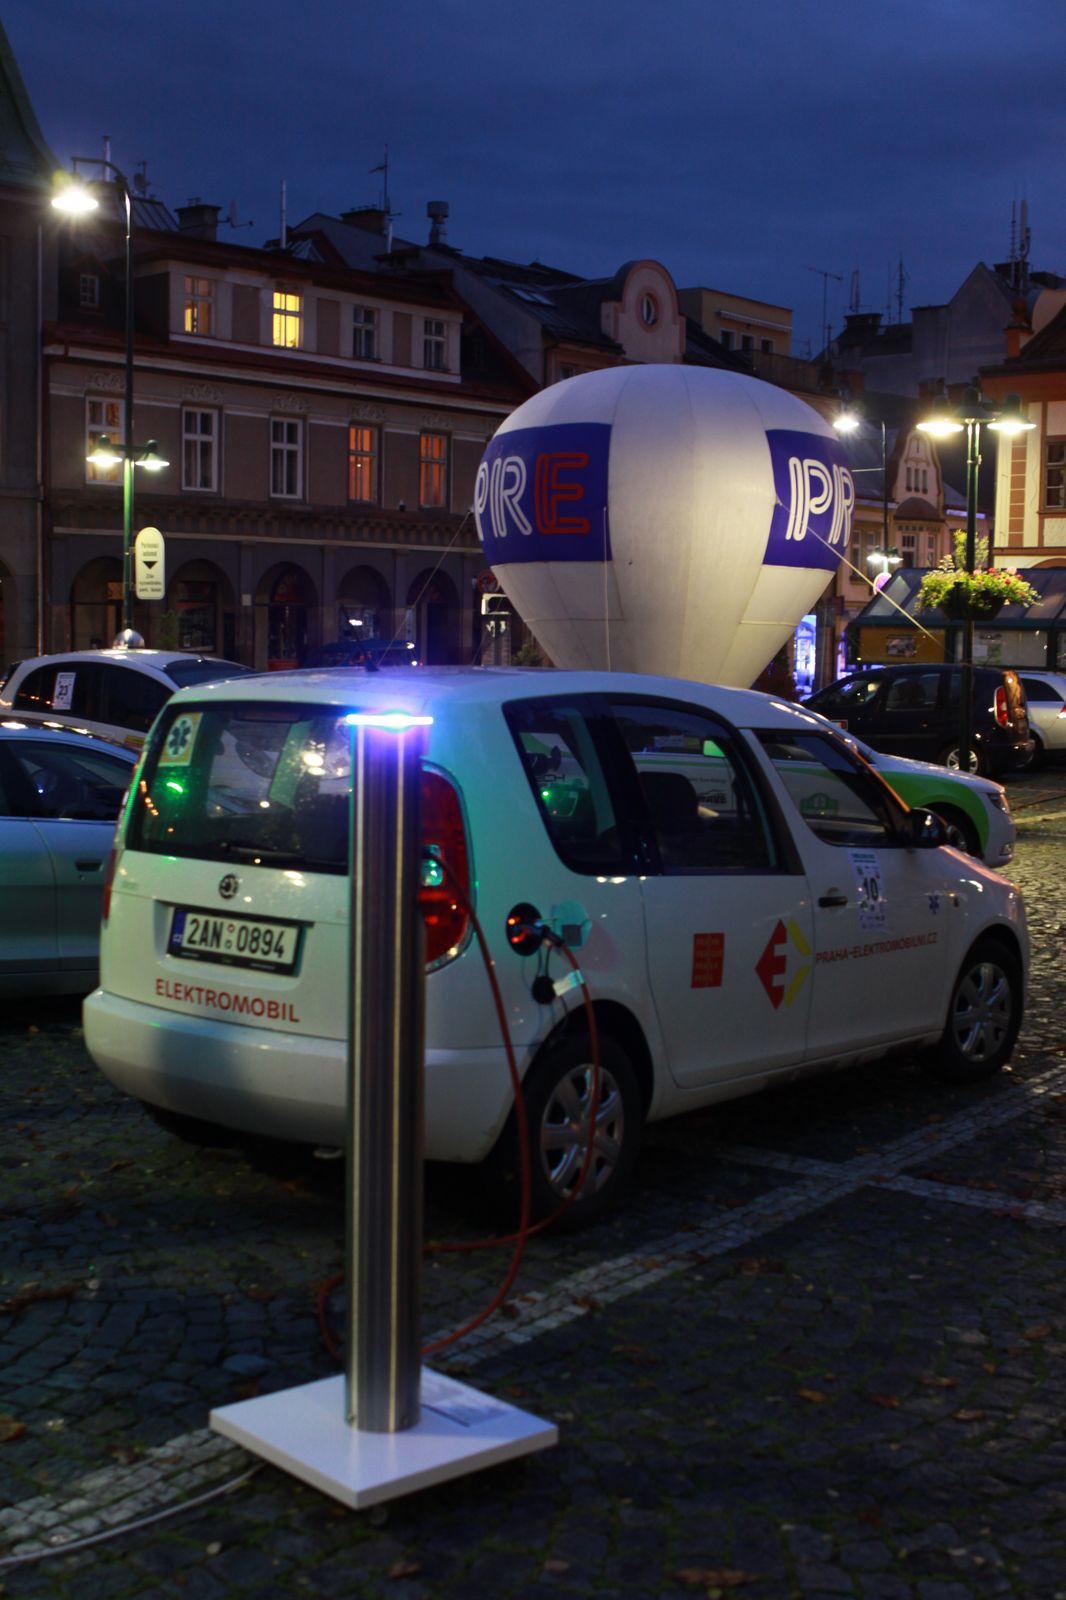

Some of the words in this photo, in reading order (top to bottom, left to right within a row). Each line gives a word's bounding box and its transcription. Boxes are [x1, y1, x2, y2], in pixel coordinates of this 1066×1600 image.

[862, 876, 879, 901] 10
[187, 918, 224, 948] 2AN
[236, 925, 285, 958] 0894
[155, 978, 299, 1023] ELEKTROMOBIL
